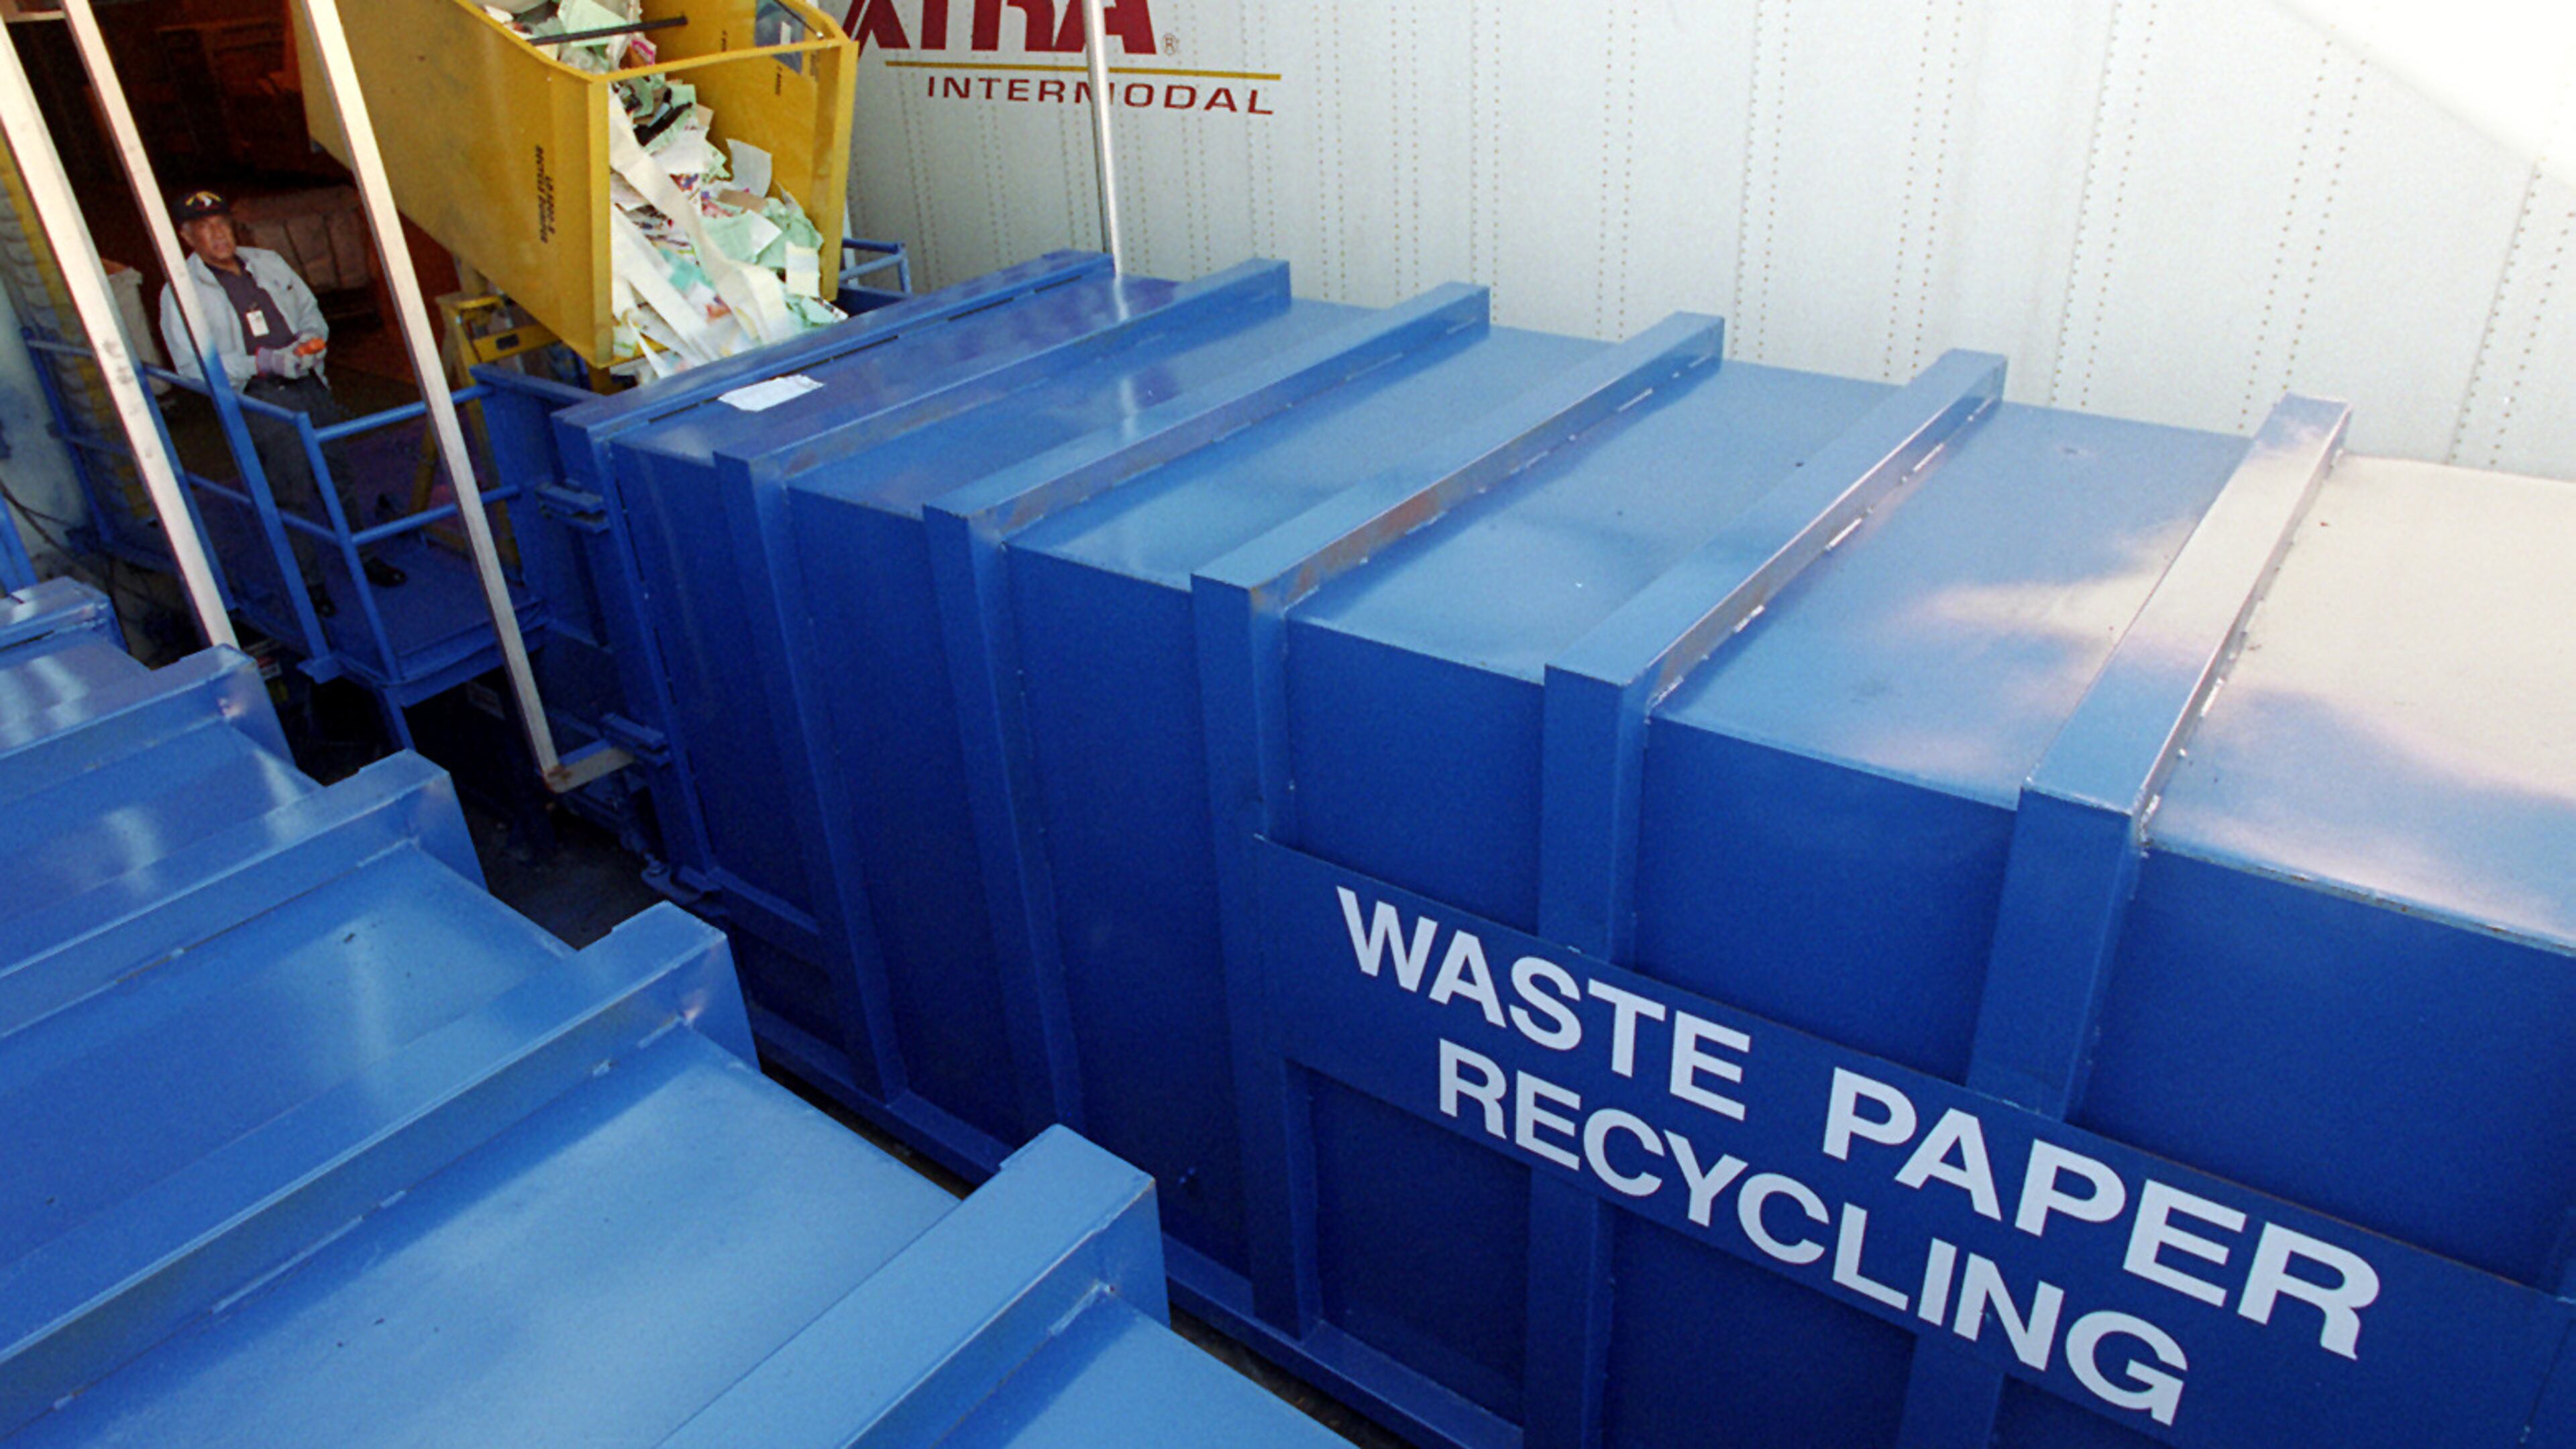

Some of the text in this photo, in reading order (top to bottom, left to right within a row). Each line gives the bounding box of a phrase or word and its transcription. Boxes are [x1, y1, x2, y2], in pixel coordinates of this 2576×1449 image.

[928, 76, 1274, 115] INTERMODAL
[1336, 886, 2379, 1360] WASTE PAPER
[1439, 1038, 2188, 1426] RECYCLING
